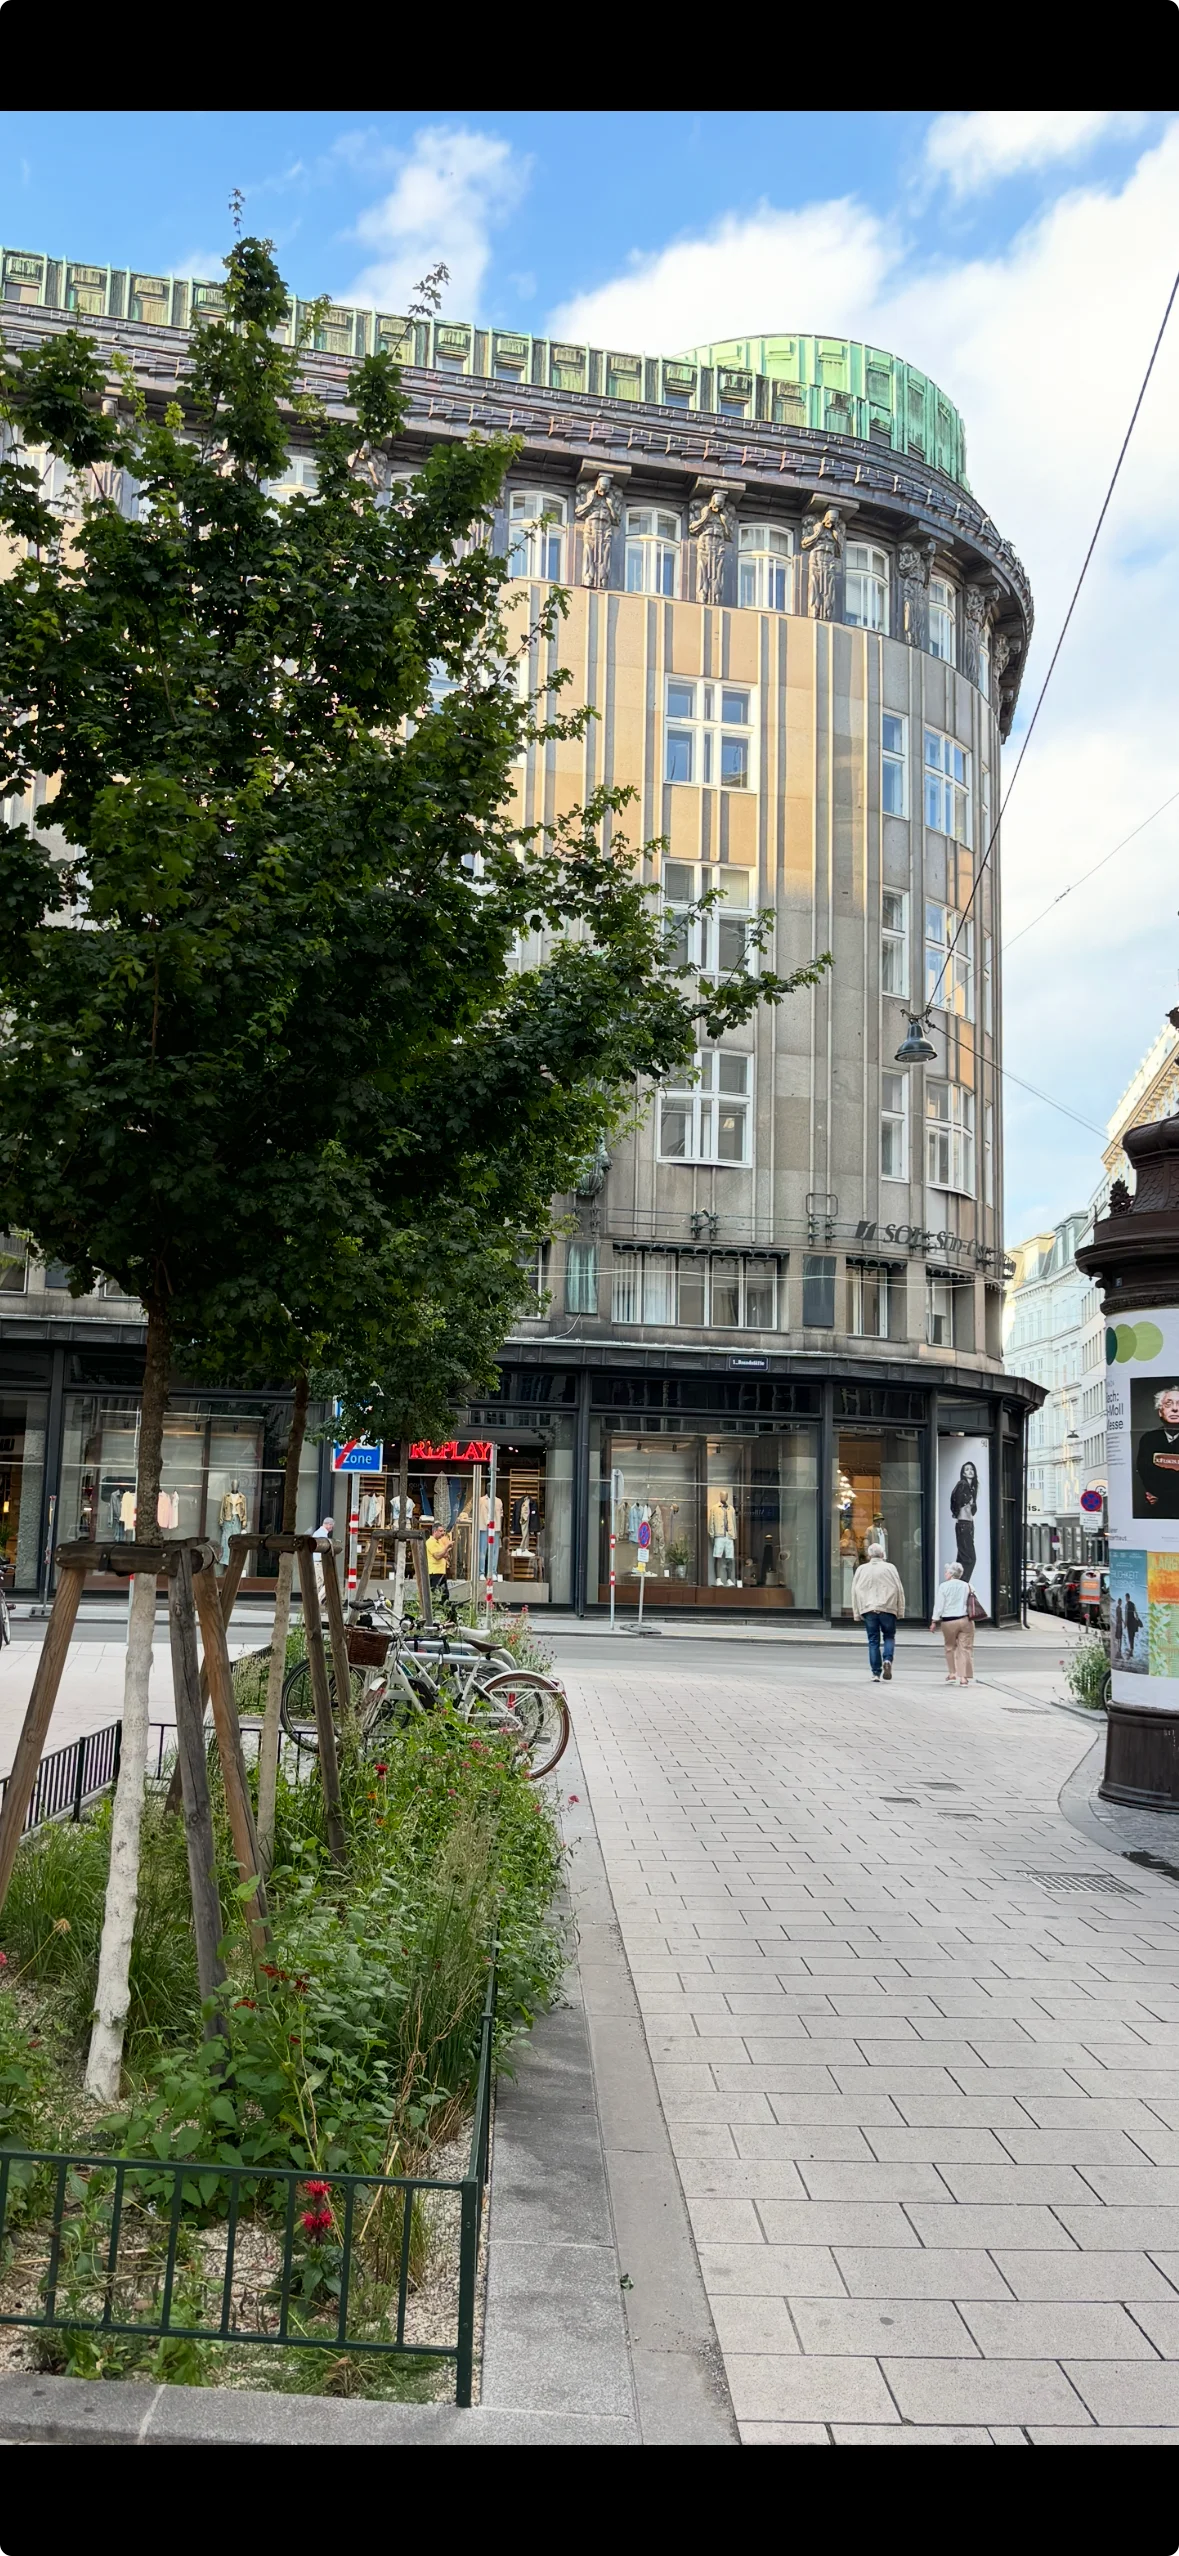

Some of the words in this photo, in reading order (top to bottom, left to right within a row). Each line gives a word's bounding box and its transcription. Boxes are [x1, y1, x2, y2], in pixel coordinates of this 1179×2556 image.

[410, 1440, 491, 1460] REPLAY
[343, 1452, 372, 1465] Zone
[1026, 1503, 1041, 1512] is.
